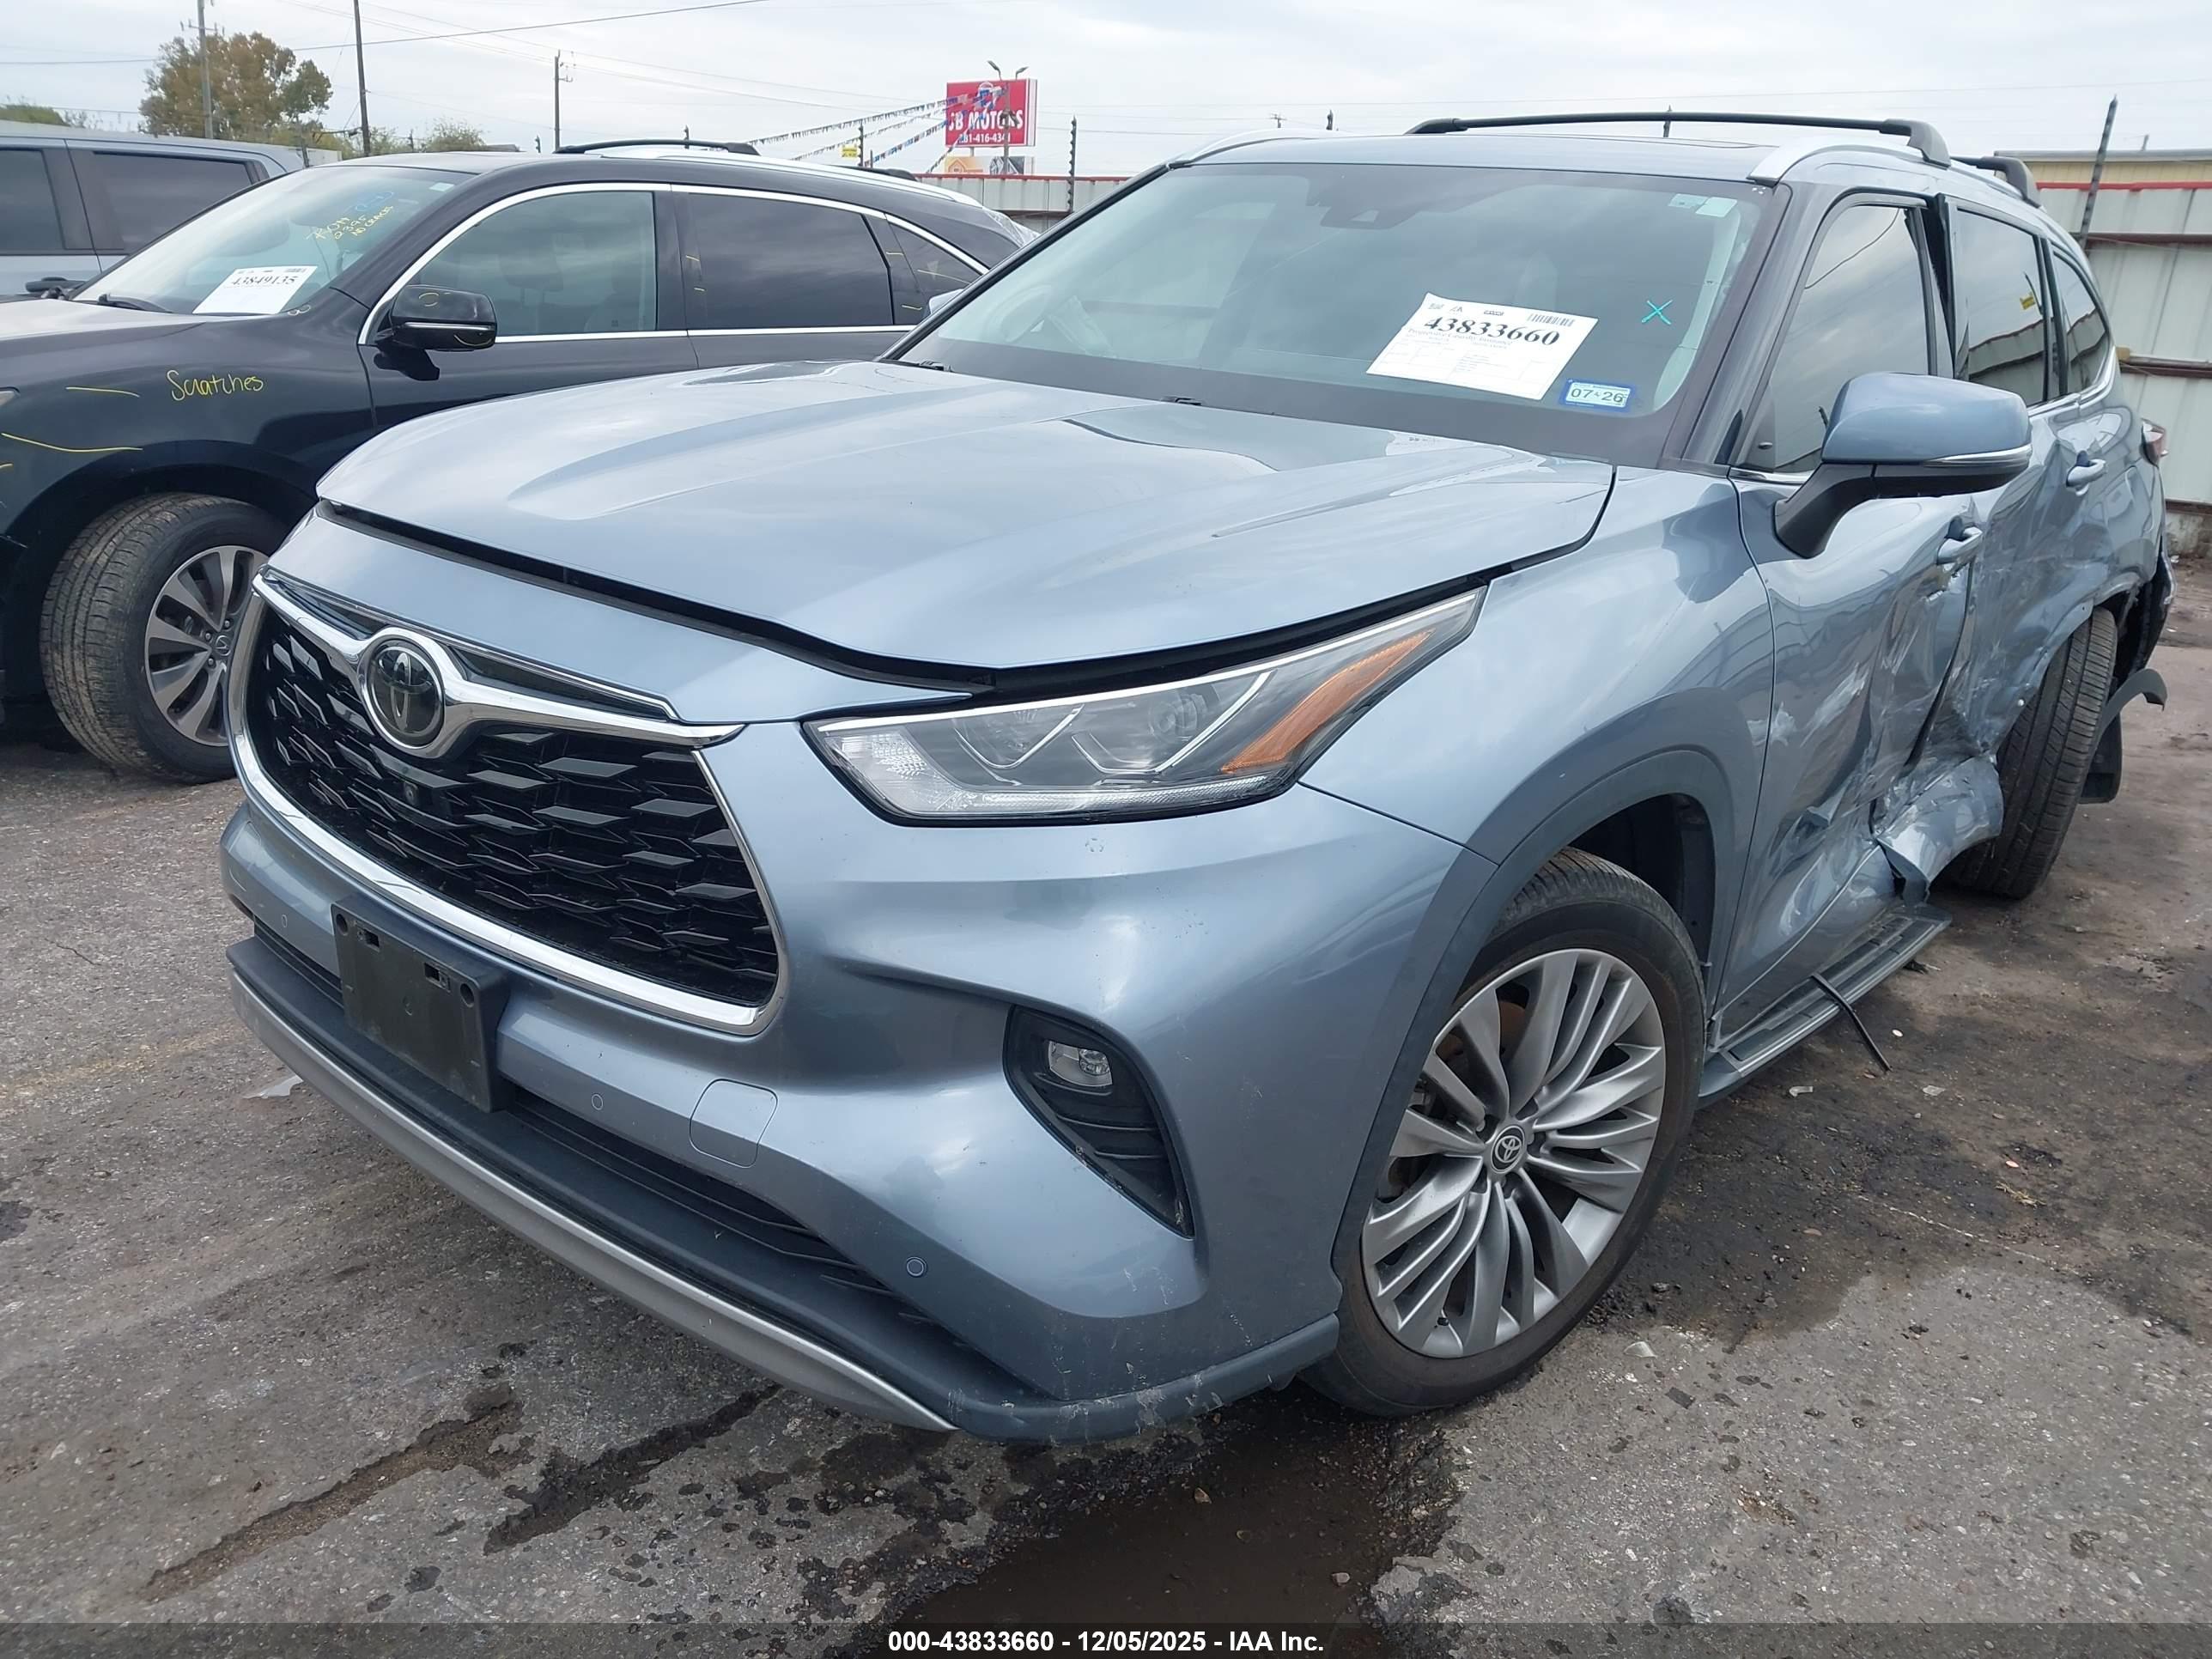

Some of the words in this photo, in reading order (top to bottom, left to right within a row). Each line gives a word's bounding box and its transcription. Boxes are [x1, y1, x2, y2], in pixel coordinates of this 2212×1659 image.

[231, 275, 299, 285] 43849135
[1424, 316, 1560, 346] 43833660
[167, 369, 264, 401] Scratches
